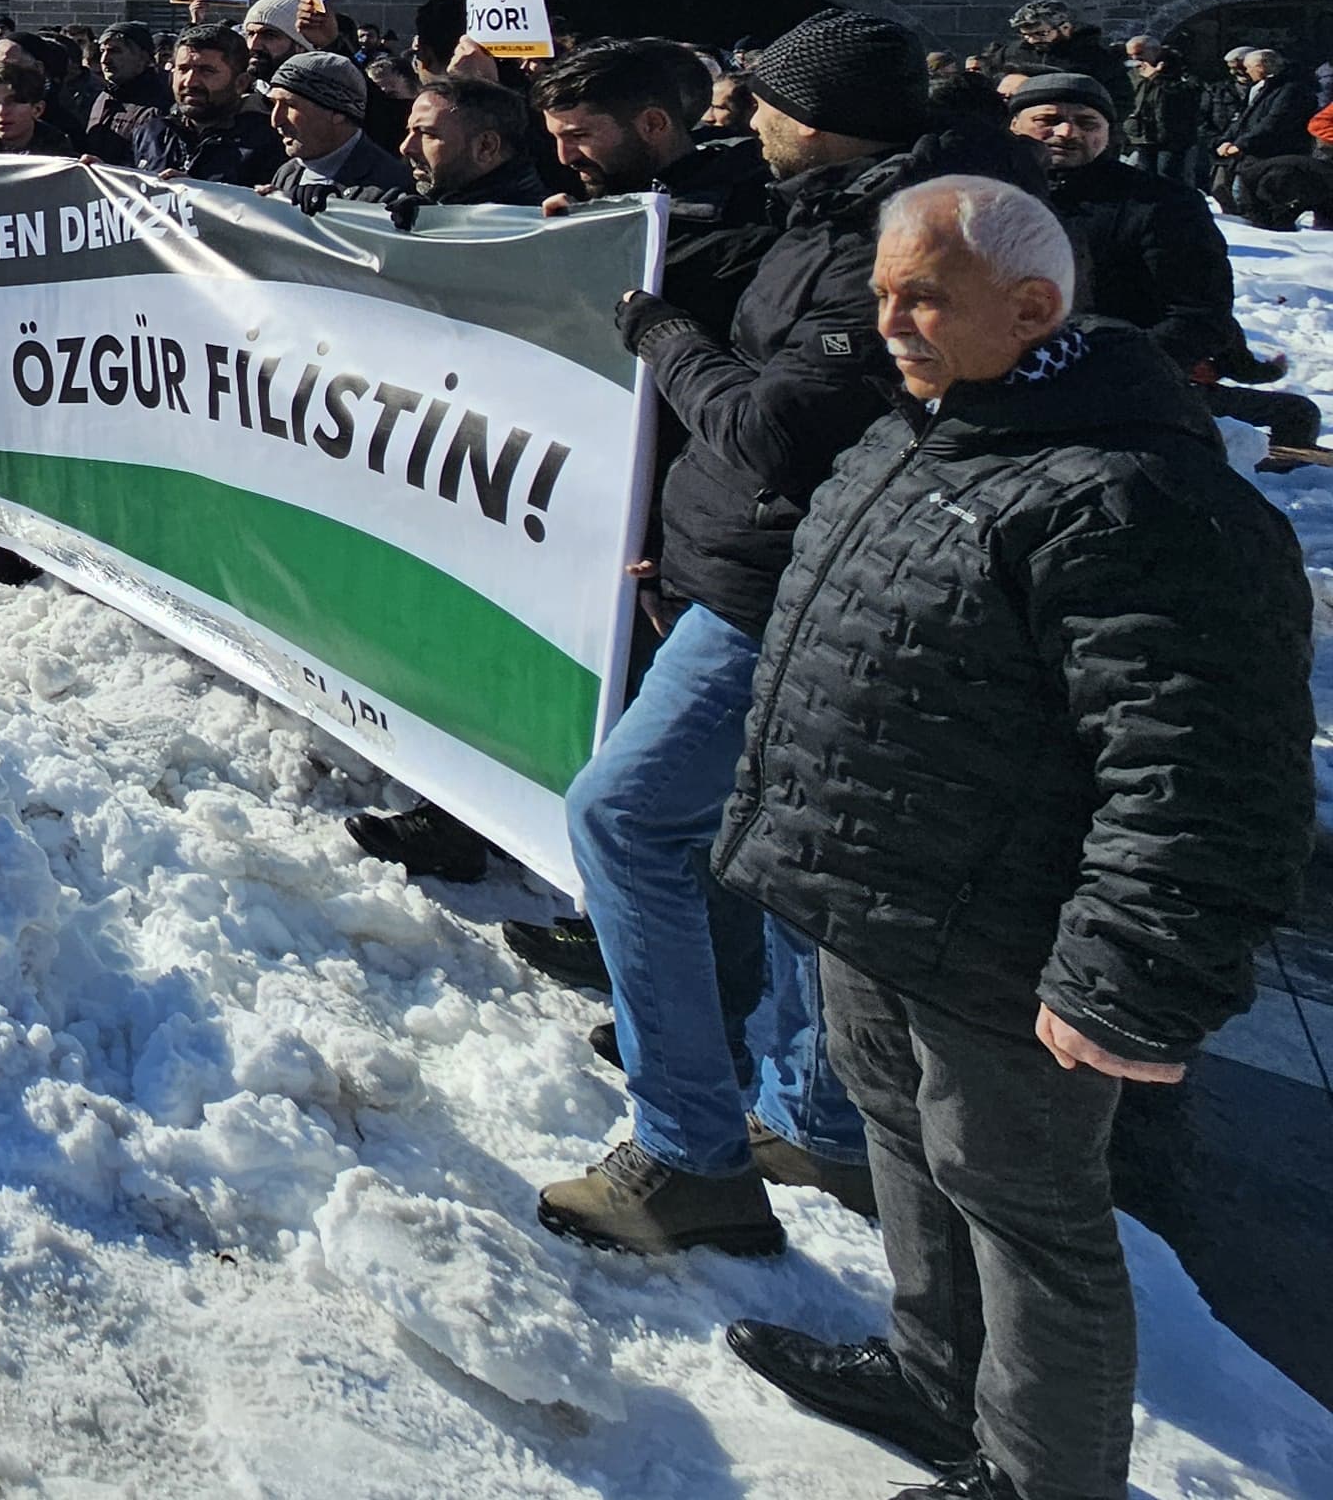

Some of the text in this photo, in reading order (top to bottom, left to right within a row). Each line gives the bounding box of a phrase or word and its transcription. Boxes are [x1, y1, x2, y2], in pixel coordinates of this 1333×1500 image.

[468, 4, 529, 31] ÜYOR!
[12, 314, 192, 416] ÖZGÜR
[205, 327, 573, 544] FİLİSTİN!
